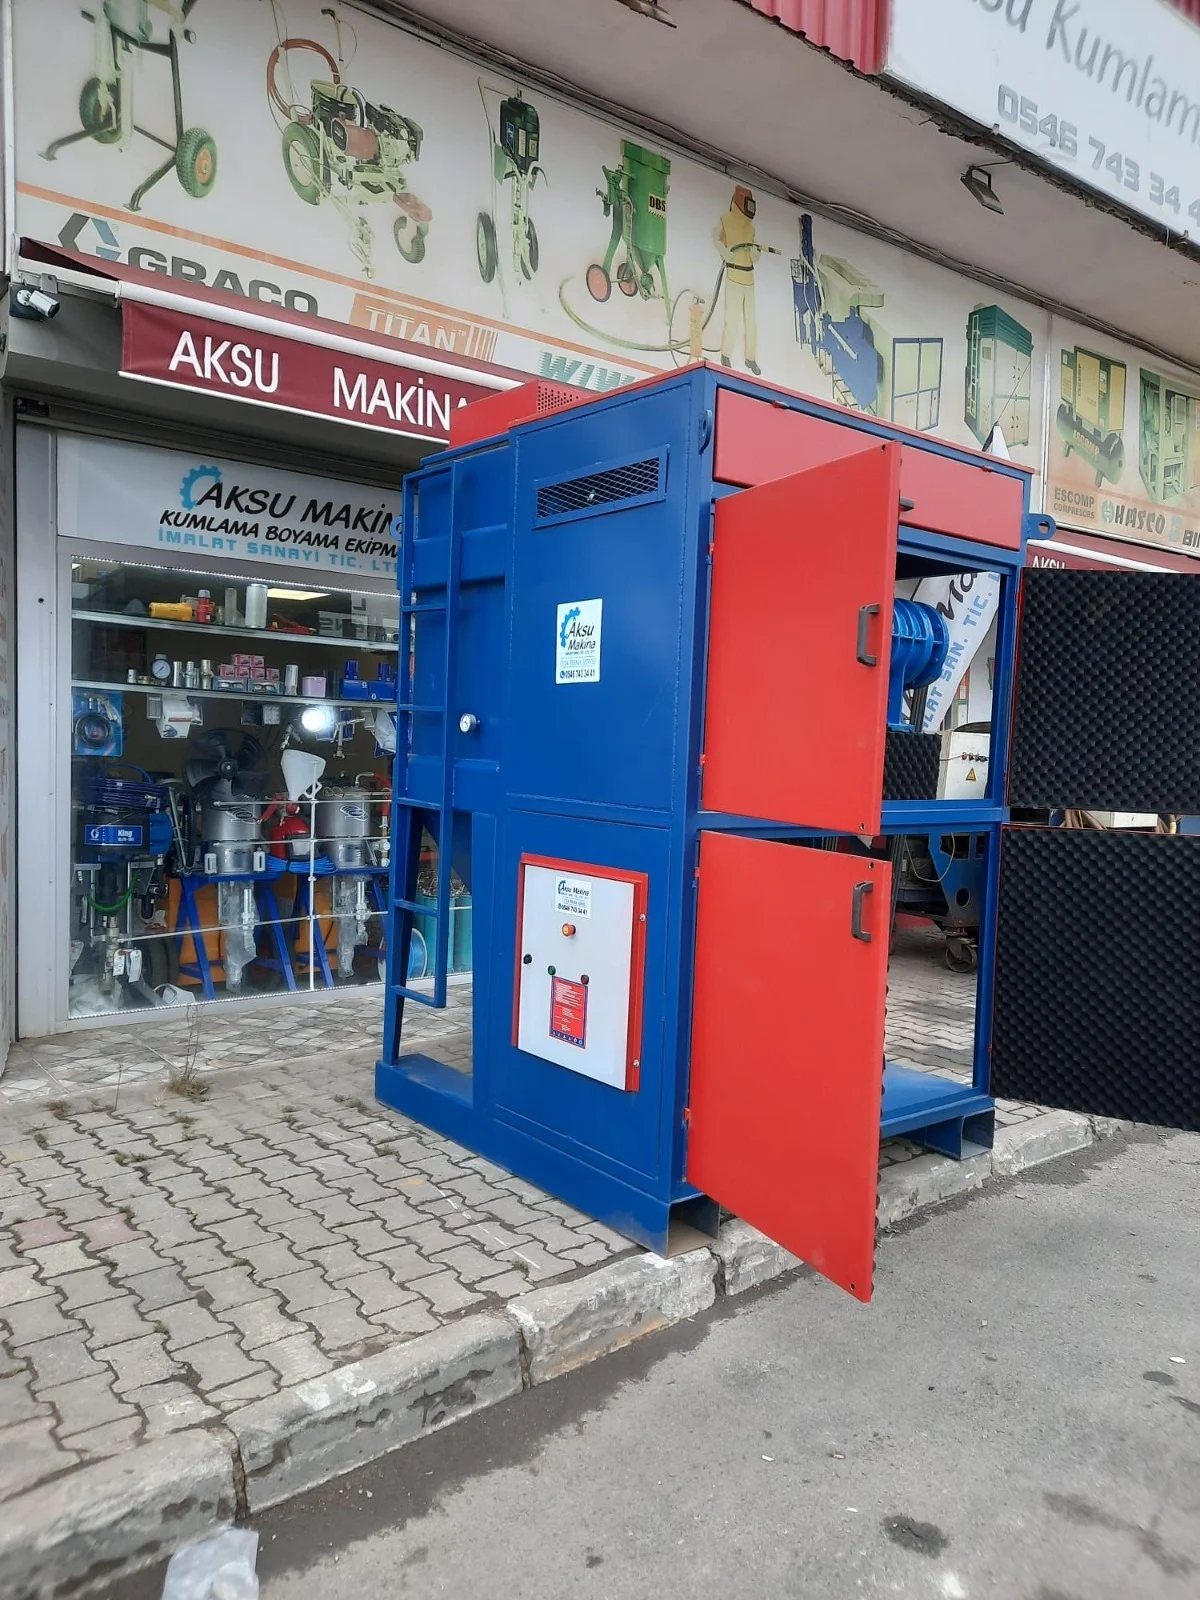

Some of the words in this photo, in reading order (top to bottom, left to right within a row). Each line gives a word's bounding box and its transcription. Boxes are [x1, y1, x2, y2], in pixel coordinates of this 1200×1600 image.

[998, 84, 1077, 157] 0546
[1089, 136, 1140, 193] 743
[1149, 172, 1181, 214] 34
[649, 195, 666, 211] DBS
[168, 330, 279, 394] AKSU
[334, 367, 467, 431] MAKİN
[196, 482, 297, 519] AKSU
[1054, 488, 1095, 509] ESCOMP
[160, 510, 259, 538] KUMLAMA
[265, 525, 339, 550] BOYAMA
[1114, 505, 1166, 534] HASCO
[568, 621, 594, 638] Aksu
